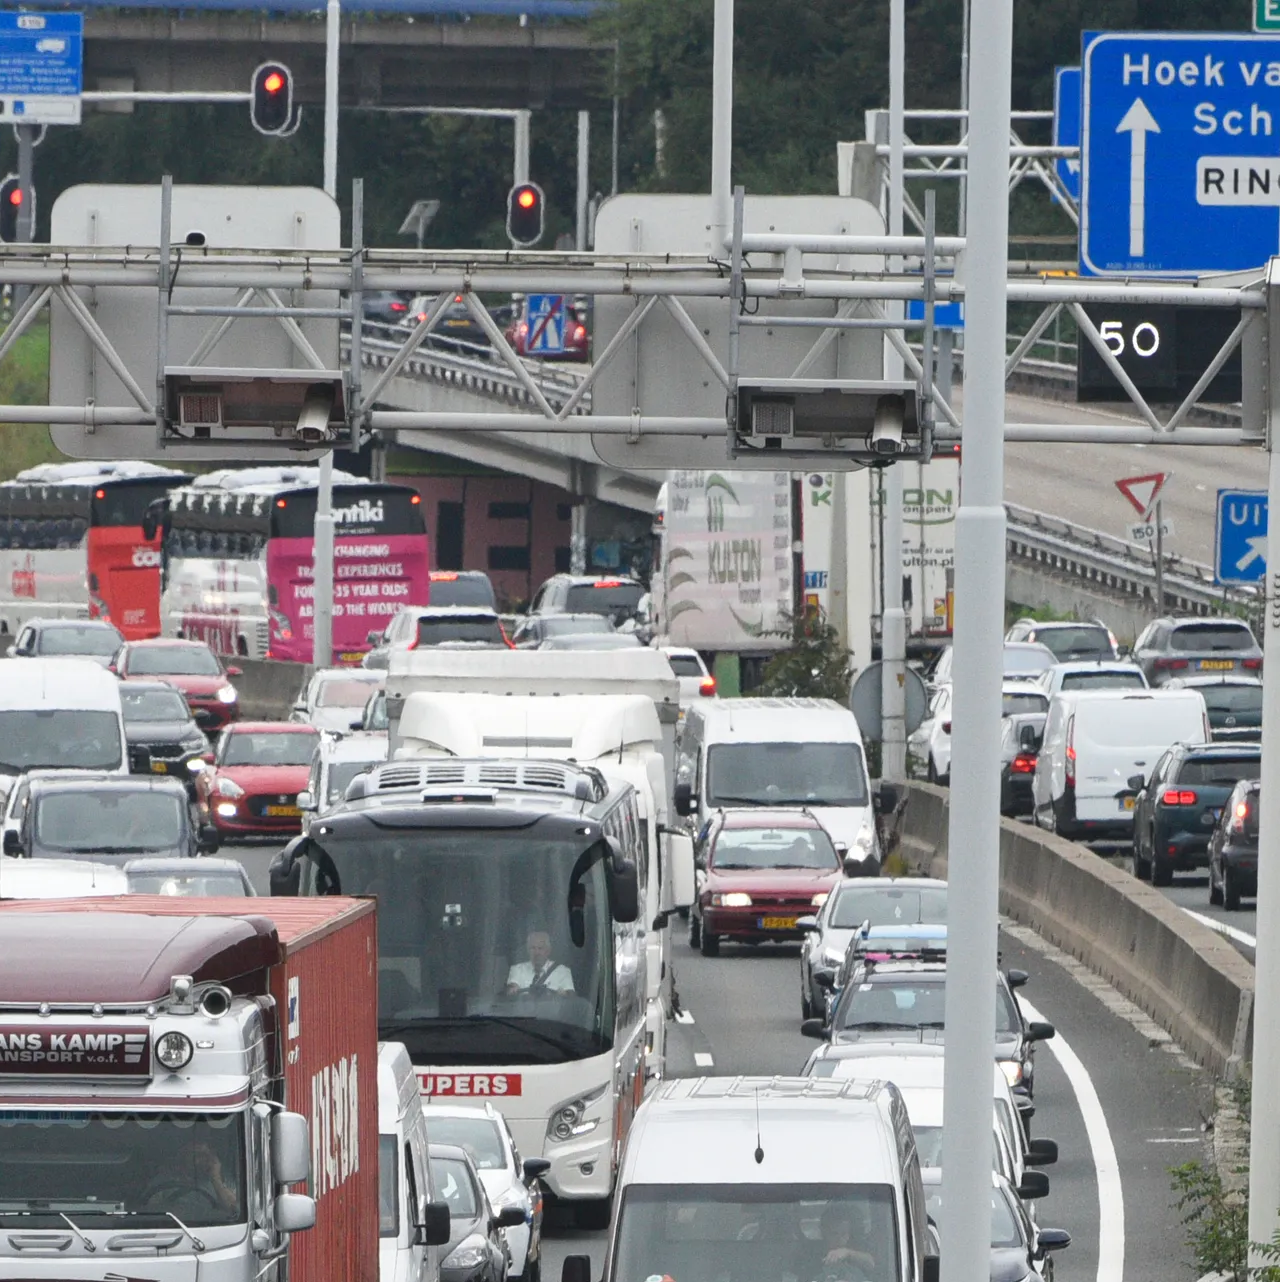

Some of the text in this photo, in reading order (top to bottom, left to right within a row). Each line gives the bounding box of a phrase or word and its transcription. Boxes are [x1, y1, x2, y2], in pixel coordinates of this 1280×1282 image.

[1122, 54, 1225, 86] Hoek
[1099, 321, 1160, 358] 50
[1229, 503, 1269, 526] UI
[1131, 525, 1154, 540] 150
[50, 1033, 123, 1052] KAMP
